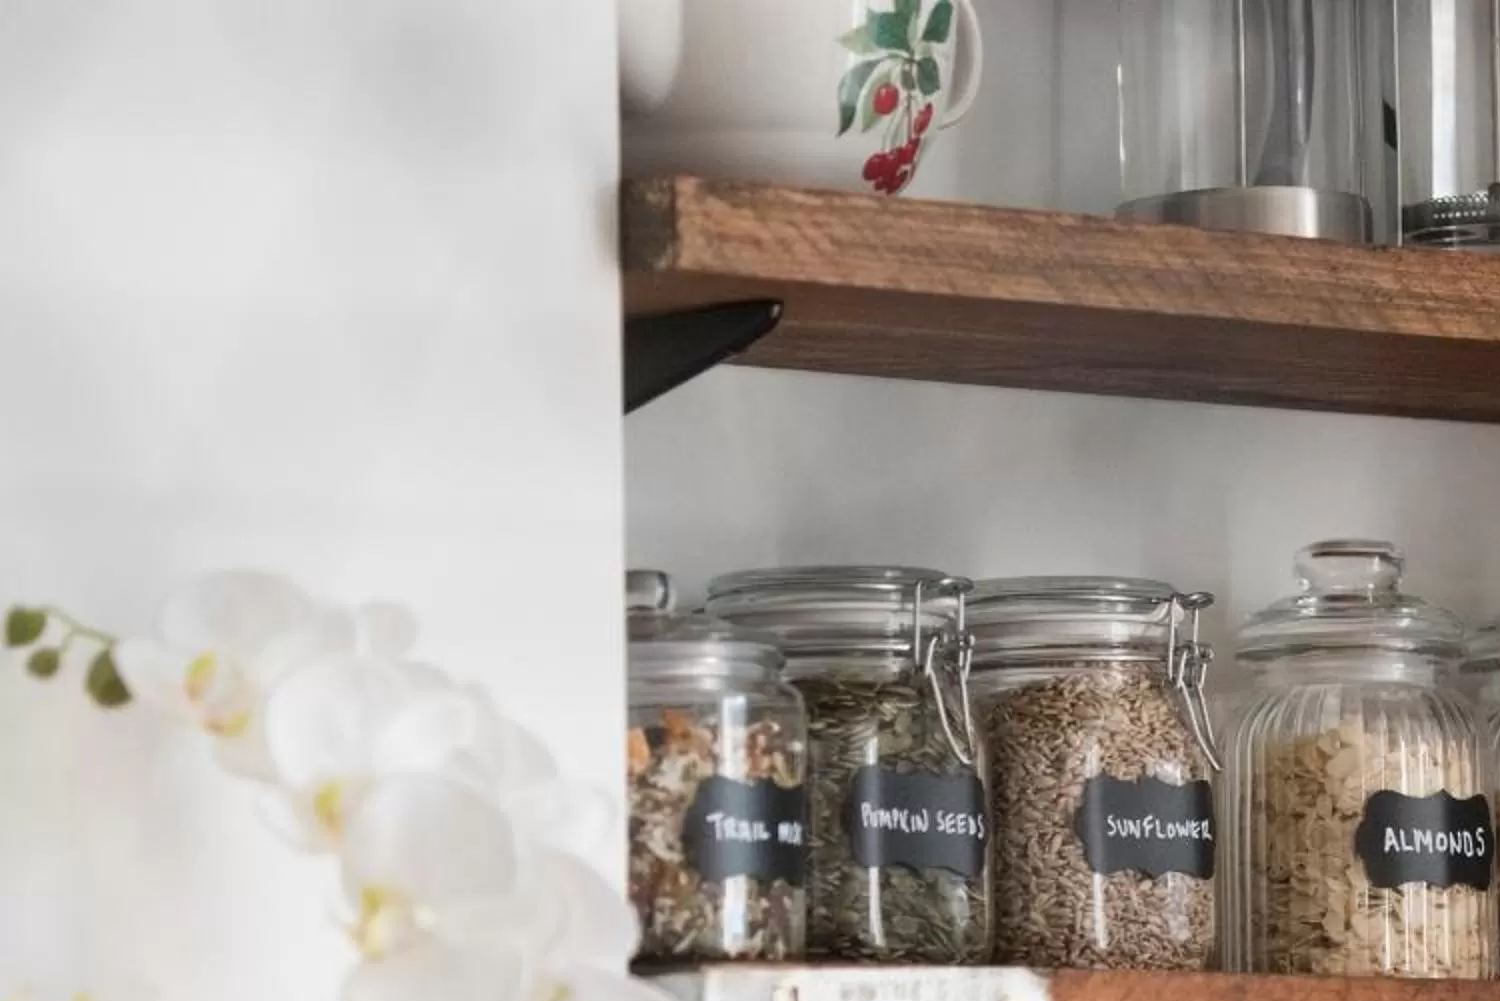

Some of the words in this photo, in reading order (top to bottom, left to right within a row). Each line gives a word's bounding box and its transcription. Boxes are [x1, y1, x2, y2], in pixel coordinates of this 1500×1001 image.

[861, 801, 929, 833] PUMPKIN
[936, 809, 985, 840] SEEDS
[1106, 813, 1213, 841] SUNFLOWER
[1383, 826, 1486, 858] ALMONDS
